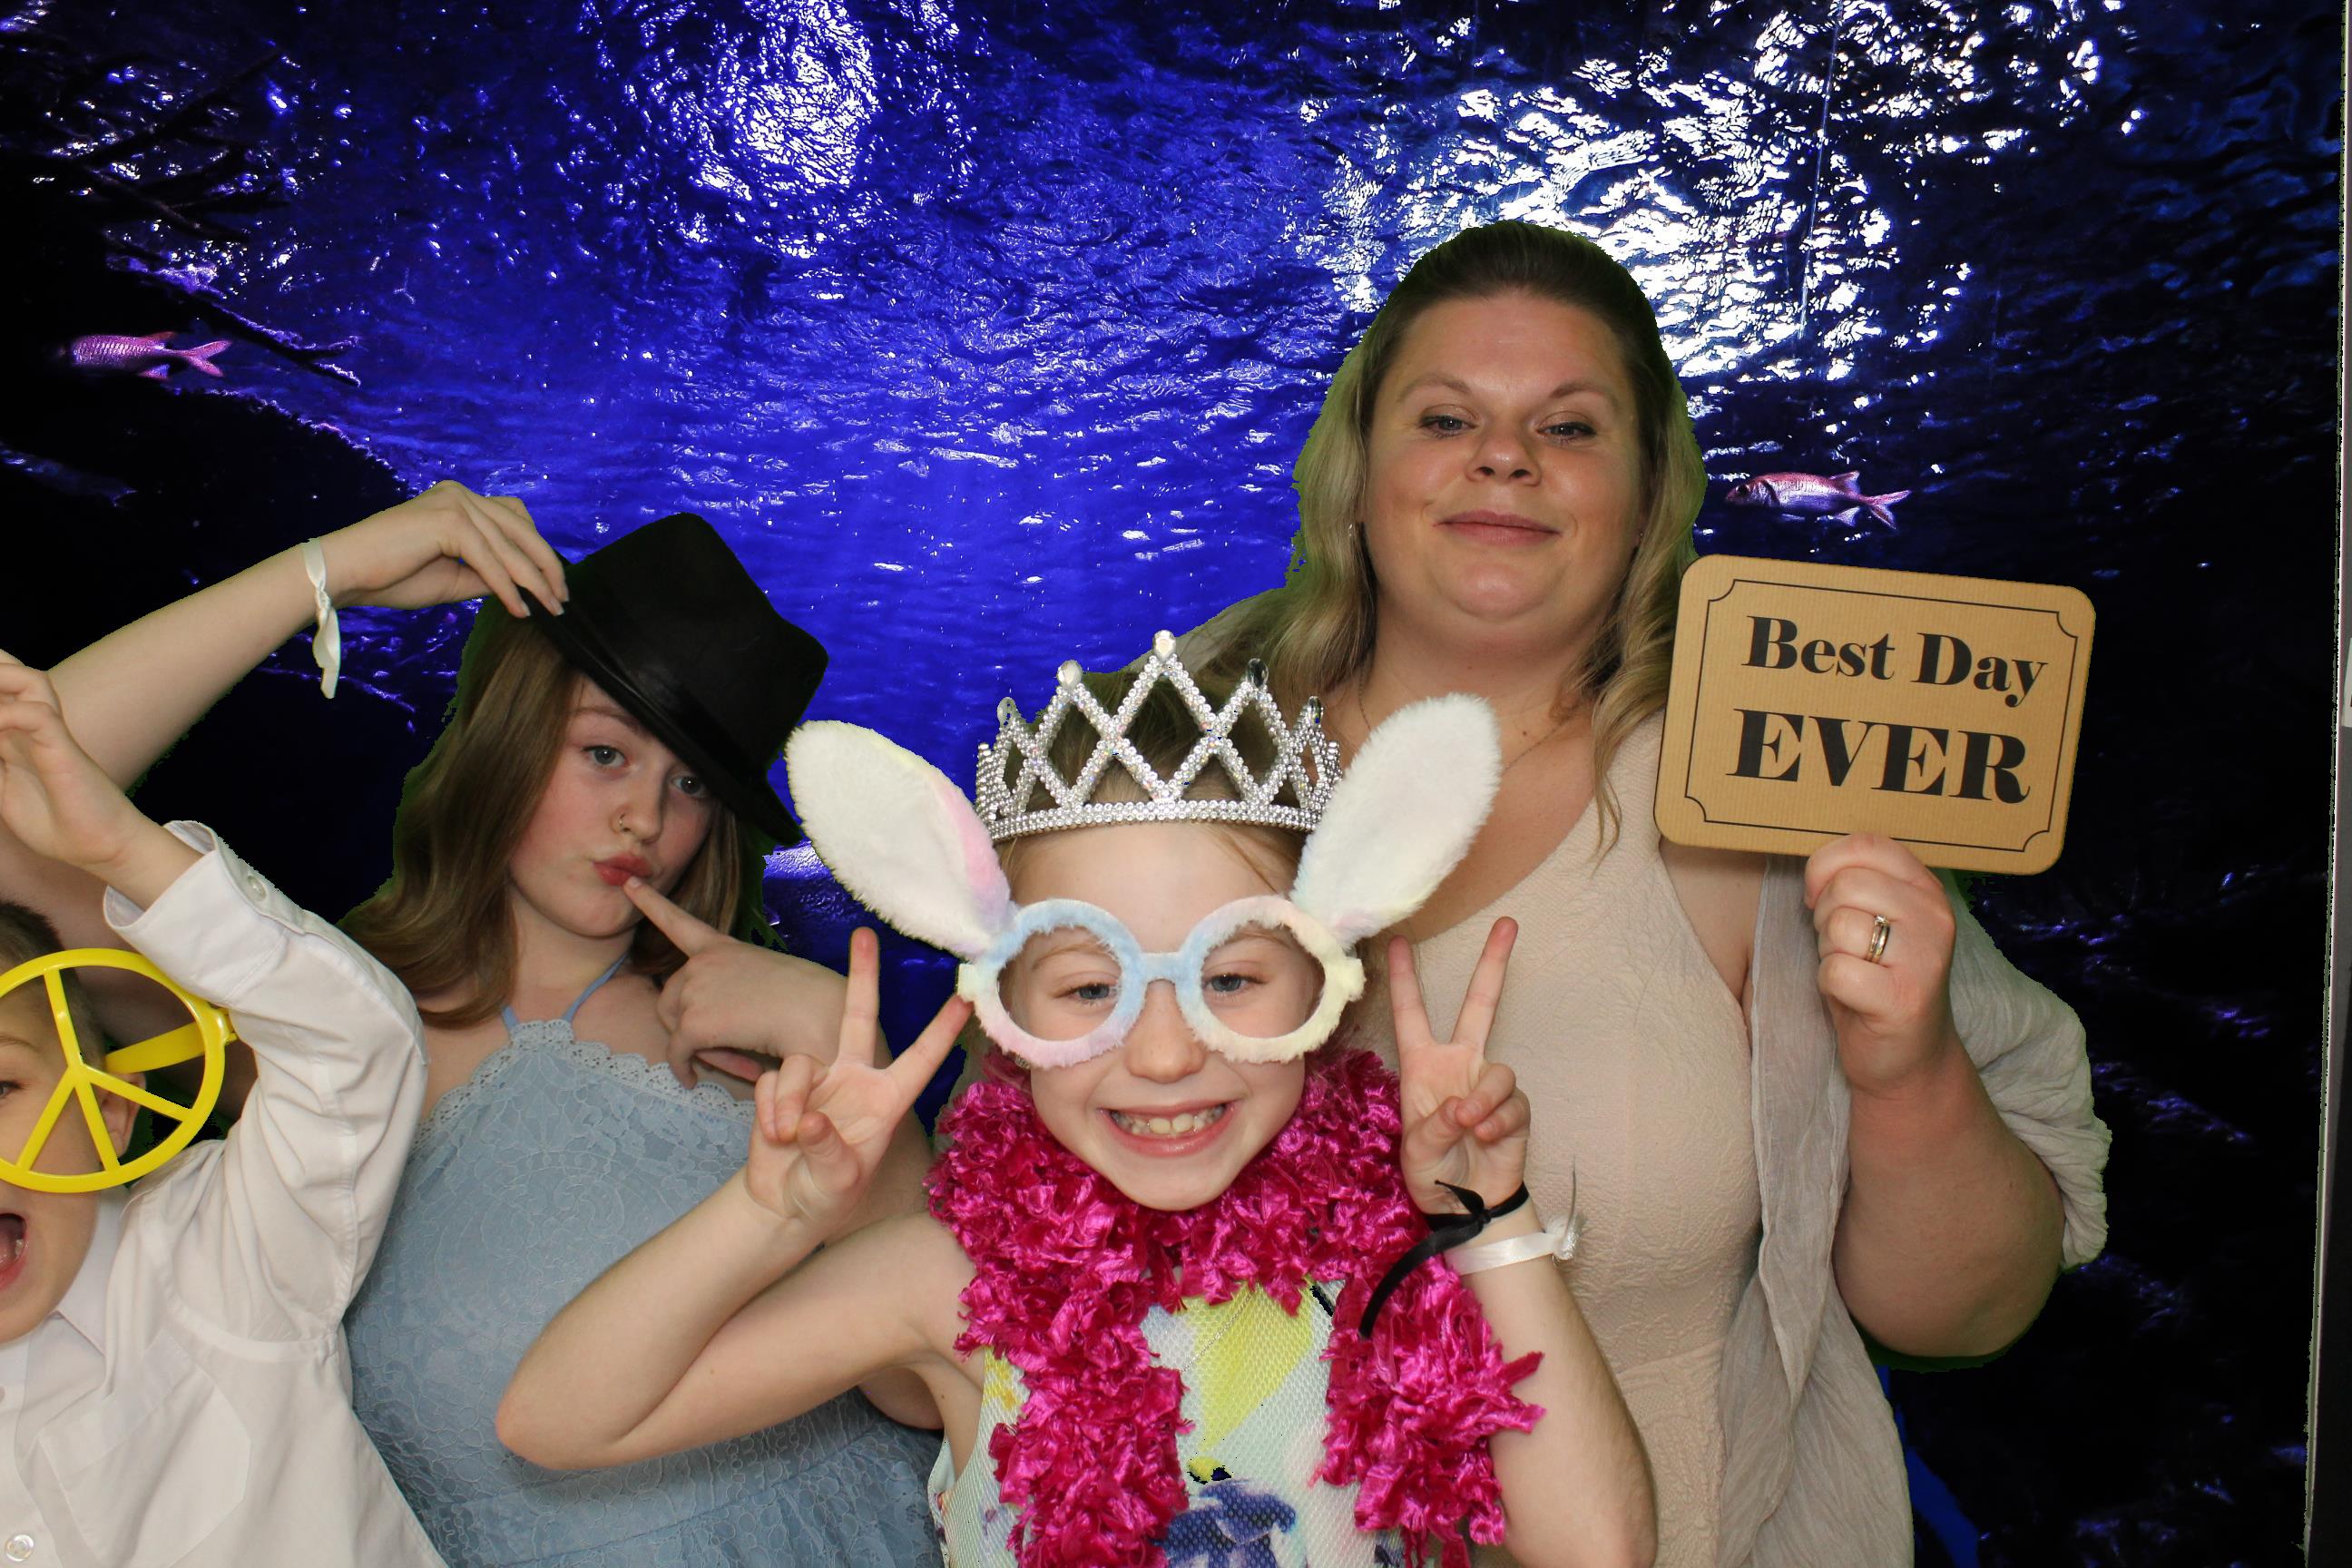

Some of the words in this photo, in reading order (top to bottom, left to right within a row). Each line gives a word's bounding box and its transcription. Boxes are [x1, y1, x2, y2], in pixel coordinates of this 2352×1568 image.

[1740, 615, 1896, 681] Best
[1909, 632, 2050, 709] Day
[1725, 708, 2032, 805] EVER
